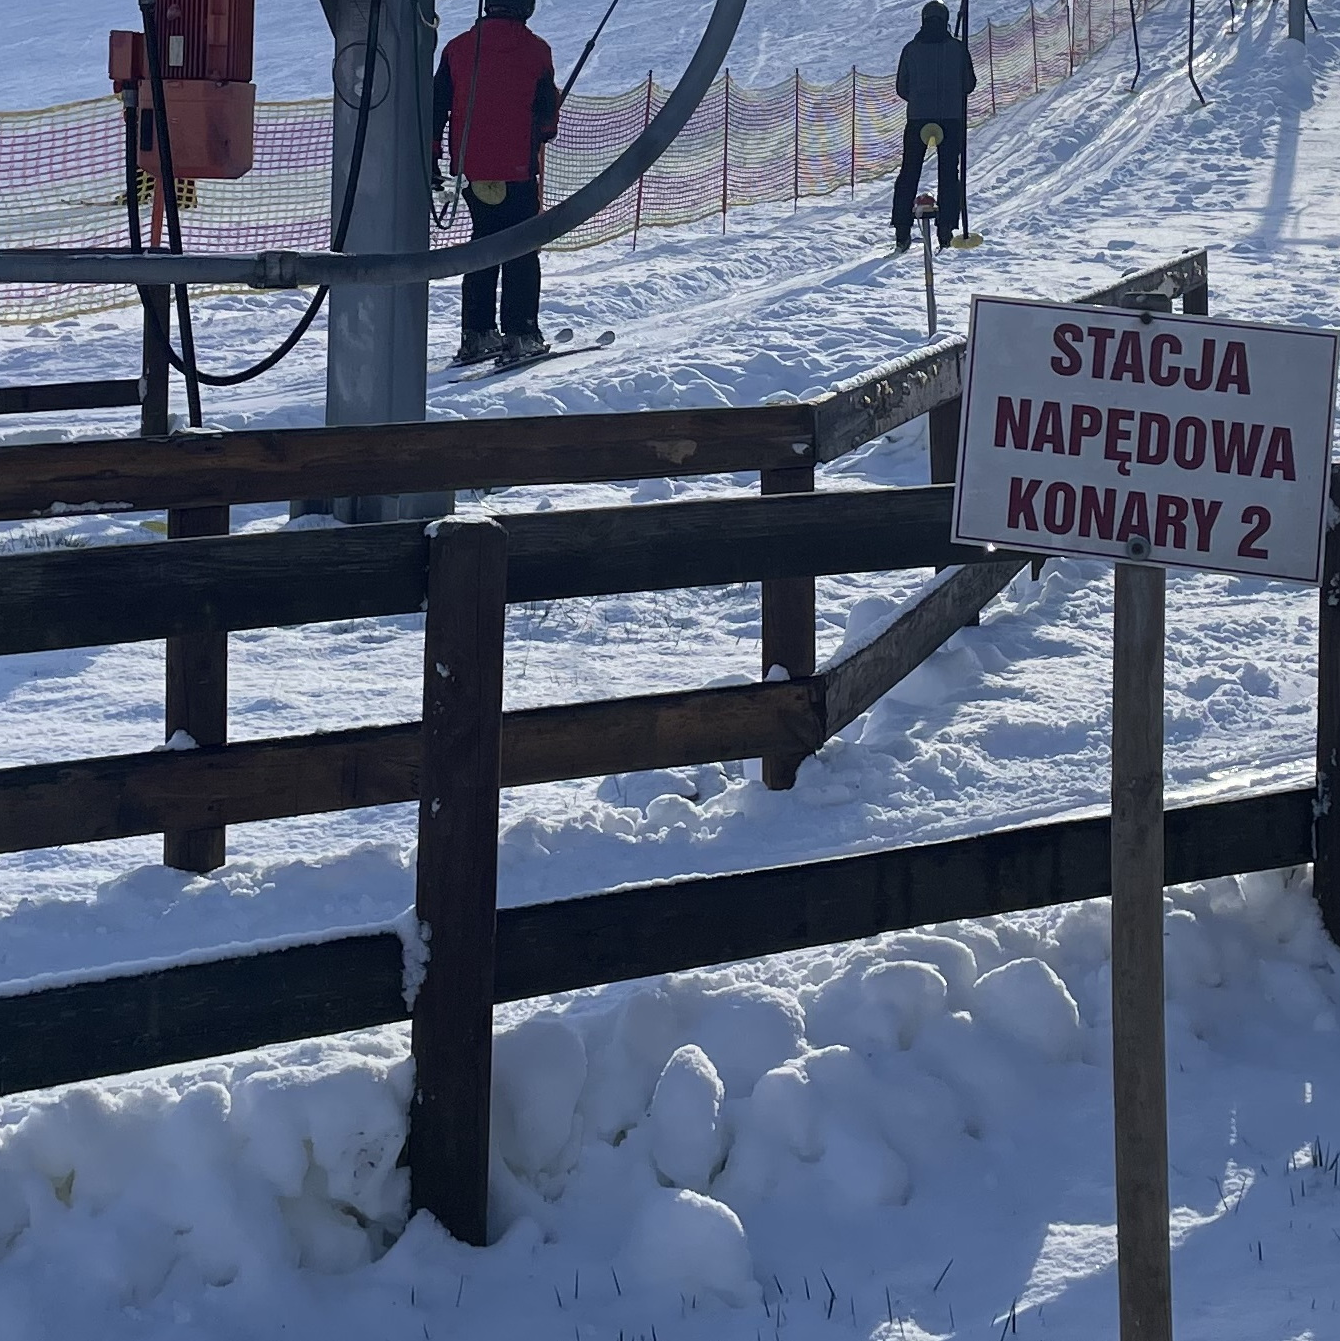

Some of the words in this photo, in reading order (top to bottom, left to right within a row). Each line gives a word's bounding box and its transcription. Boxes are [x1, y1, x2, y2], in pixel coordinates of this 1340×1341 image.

[1050, 323, 1251, 395] STACJA
[994, 396, 1296, 482] NAPĘDOWA
[1007, 477, 1224, 552] KONARY
[1237, 506, 1272, 560] 2
